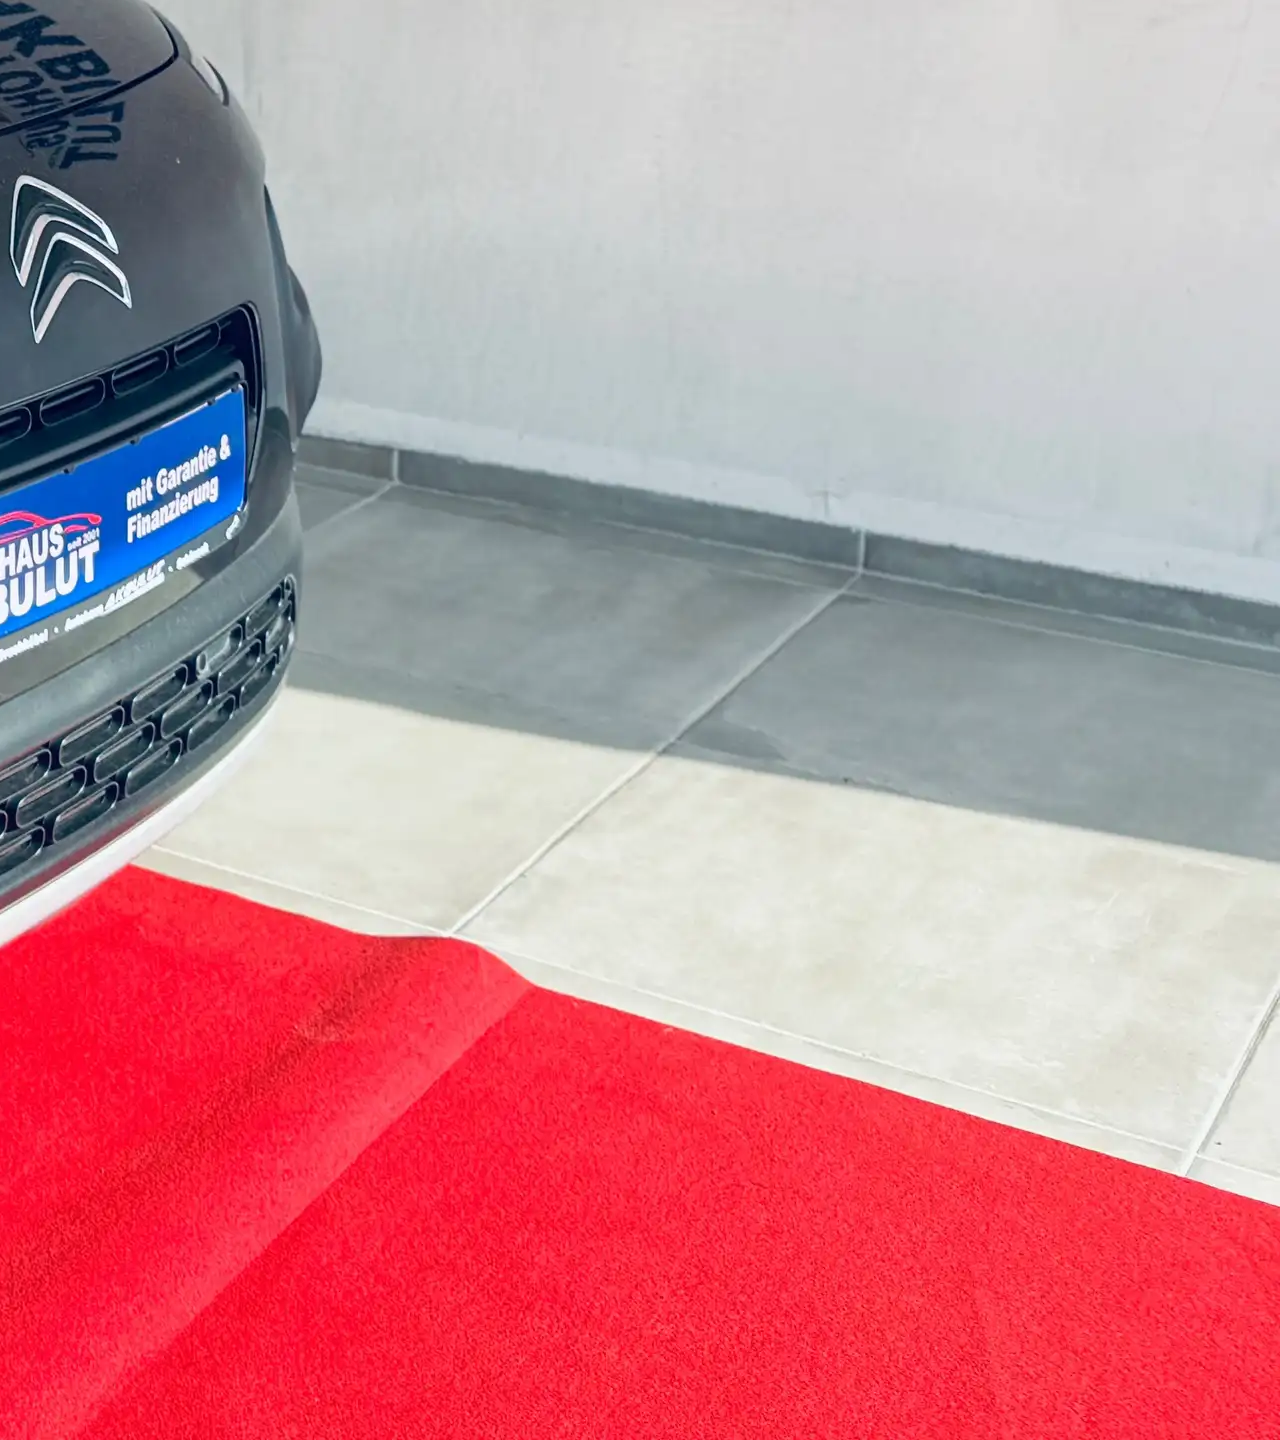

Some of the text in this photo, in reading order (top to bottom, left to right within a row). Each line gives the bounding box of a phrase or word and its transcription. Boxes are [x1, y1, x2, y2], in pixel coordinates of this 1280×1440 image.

[126, 434, 231, 511] mit Garantie &
[127, 475, 219, 543] Finanzierung
